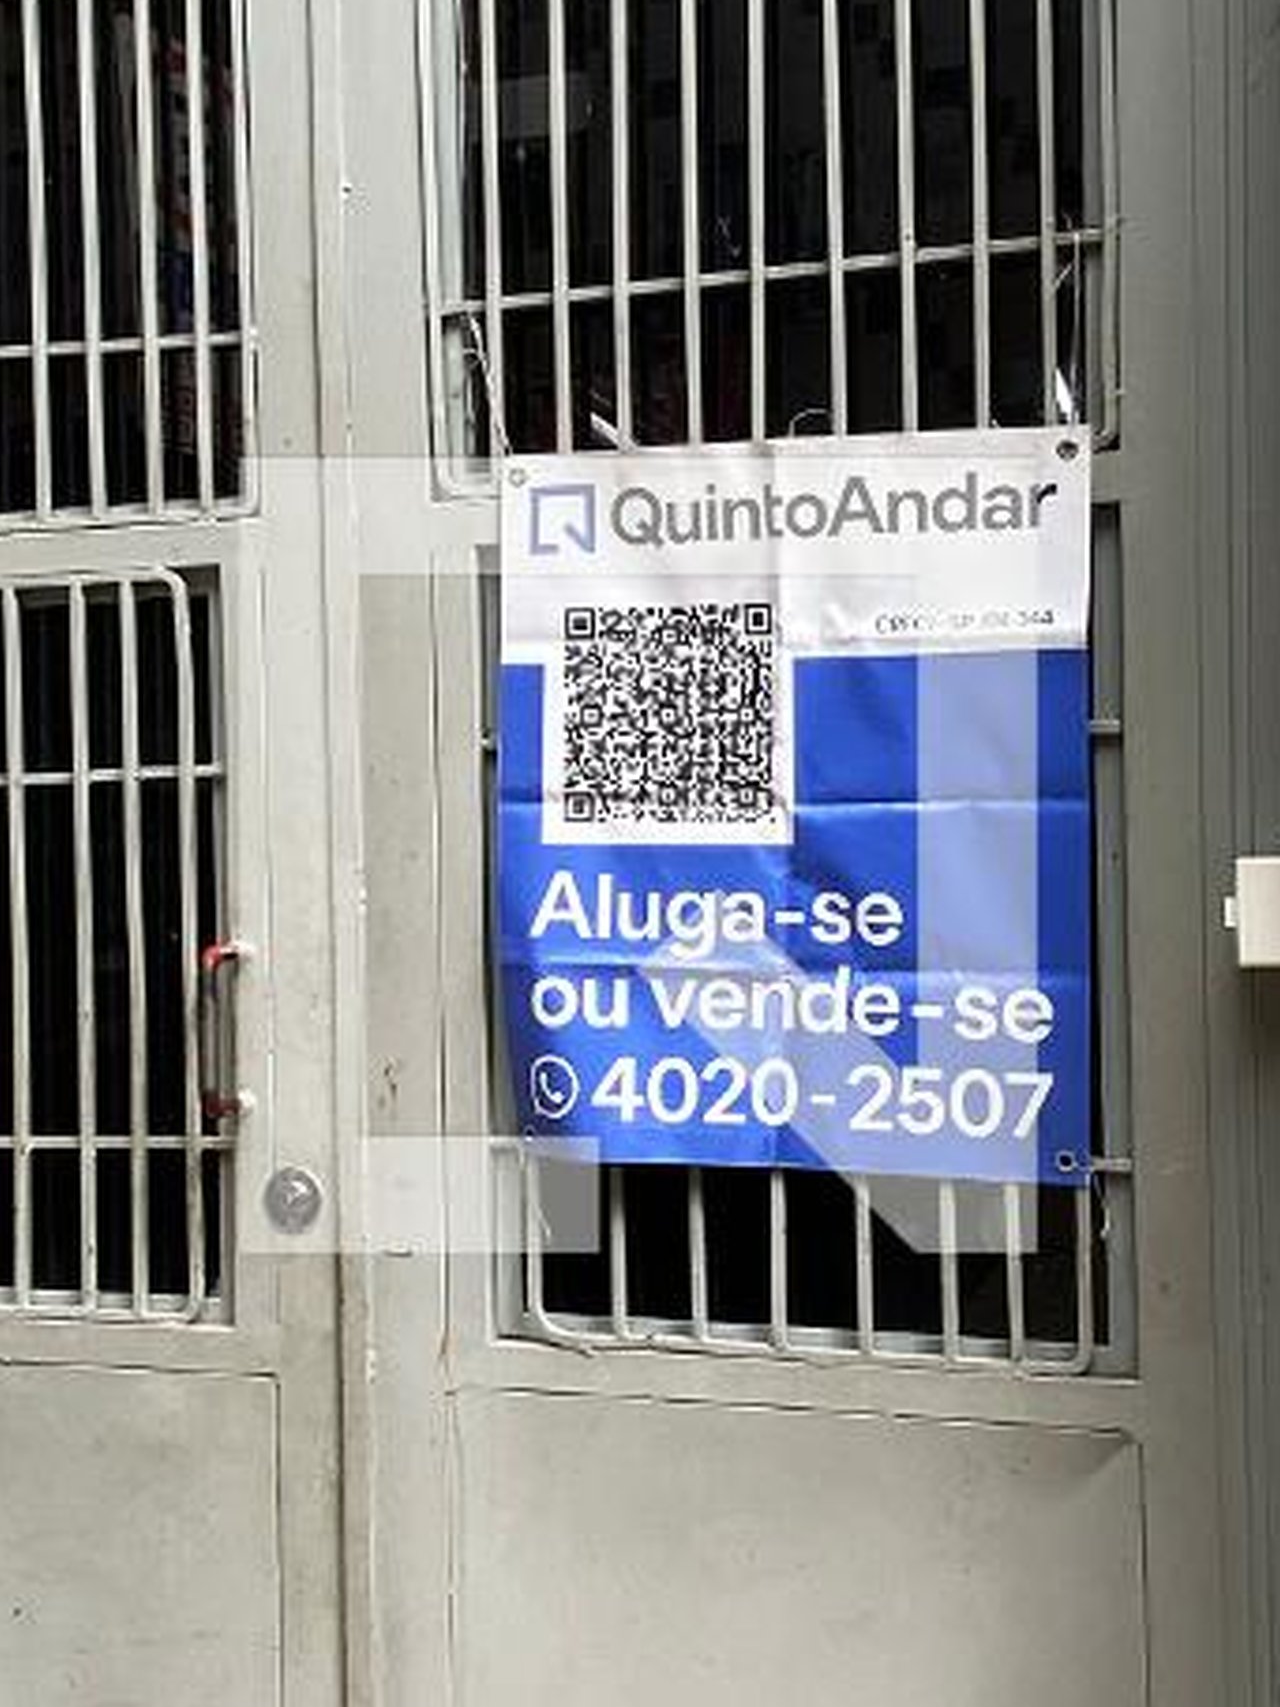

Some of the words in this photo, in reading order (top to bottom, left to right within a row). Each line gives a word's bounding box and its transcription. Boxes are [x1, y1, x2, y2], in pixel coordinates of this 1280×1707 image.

[610, 472, 1058, 549] QuintoAndar
[529, 870, 904, 959] Aluga-se
[531, 975, 631, 1029] ou
[649, 965, 1054, 1044] vende-se
[592, 1056, 1054, 1139] 4020-2507
